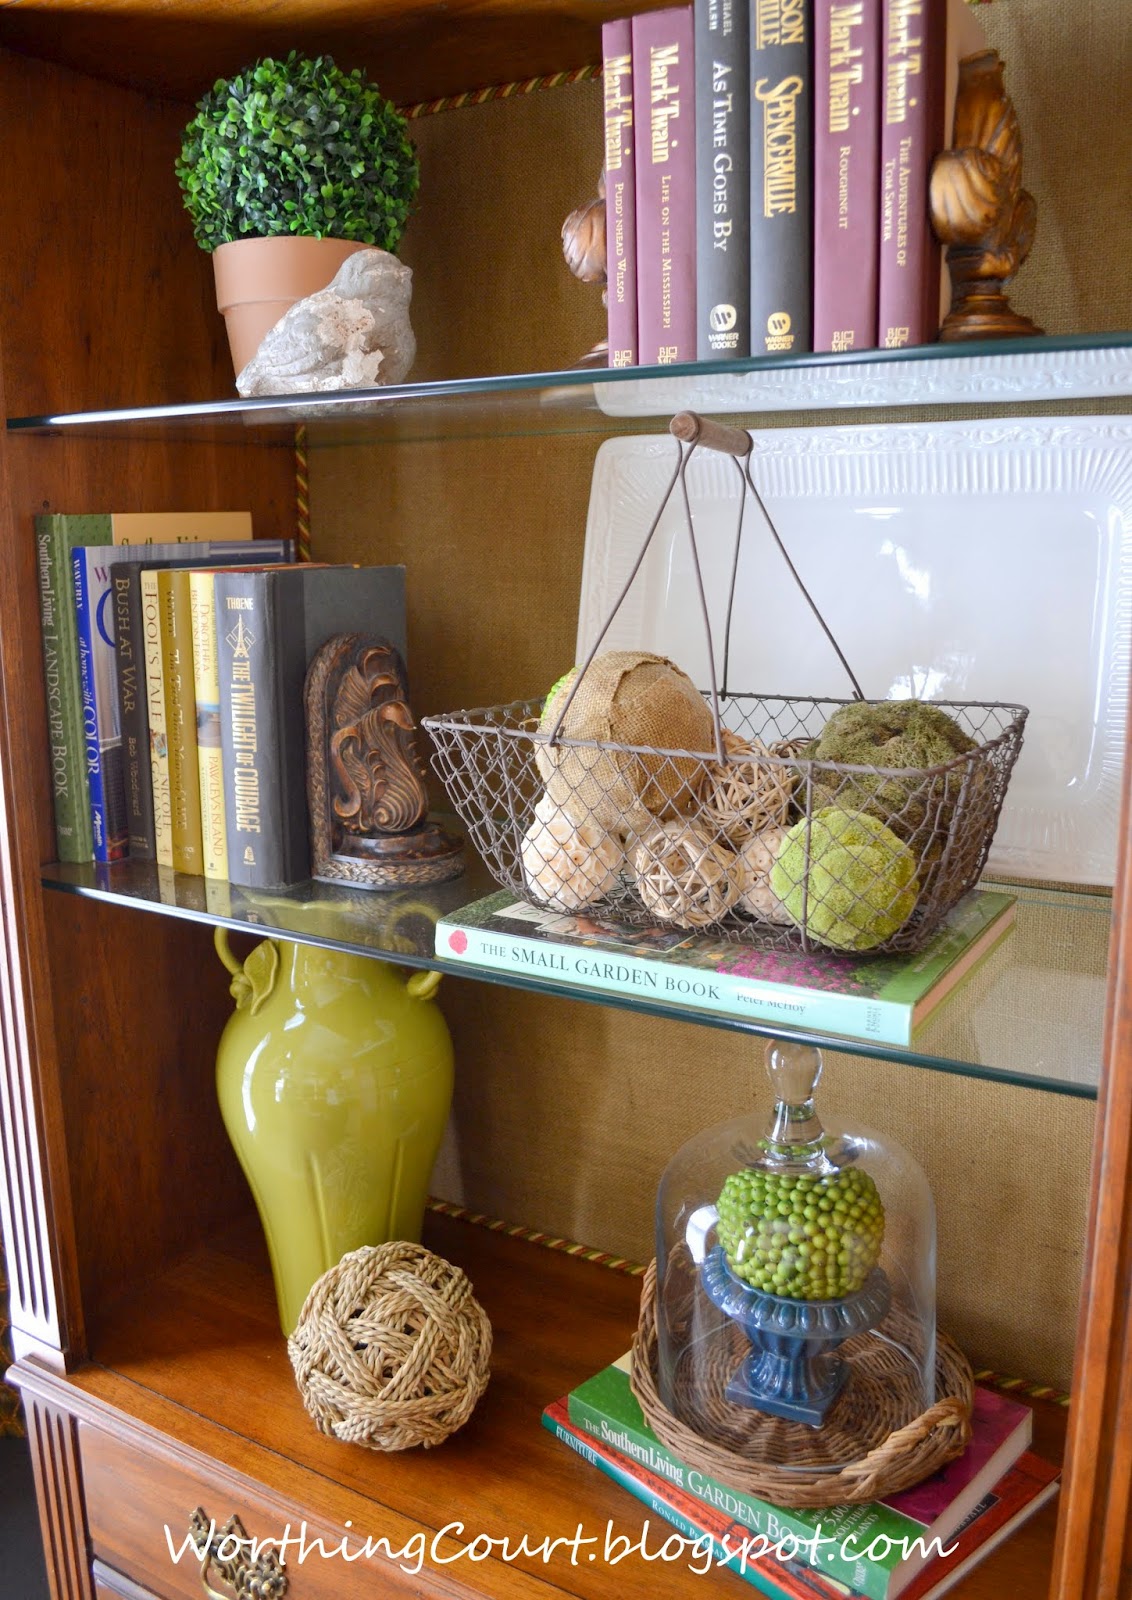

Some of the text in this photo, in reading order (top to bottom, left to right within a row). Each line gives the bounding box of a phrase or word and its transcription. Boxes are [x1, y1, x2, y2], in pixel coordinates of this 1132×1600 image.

[651, 43, 680, 165] Mark Twain
[829, 2, 864, 133] Mark Twain
[886, 0, 922, 125] Mark Twain
[604, 53, 633, 172] Mark Twain
[755, 75, 804, 218] SPENCERVILLE
[713, 60, 733, 252] AS TIME GOES BY
[839, 145, 851, 229] ROUGHING IT
[883, 158, 896, 242] TOM SAWYER
[896, 136, 912, 267] THE ADVENTURES OF
[616, 257, 627, 303] WILSON
[661, 175, 672, 329] LIFE ON THE MISSISSIPPI
[708, 332, 739, 342] WARNER
[711, 341, 738, 350] BOOKS
[764, 335, 795, 345] WARNER
[766, 342, 793, 351] BOOKS
[191, 589, 199, 640] BENTON
[200, 603, 210, 672] DOROTHEA
[225, 596, 254, 611] THOENE
[44, 636, 64, 740] LANDSCAPE
[73, 559, 83, 610] WAVERLY
[83, 705, 100, 775] COLOR
[115, 577, 142, 816] BUSH AT WAR Bob Woodward
[150, 671, 162, 722] TALE
[52, 744, 69, 798] BOOK
[231, 661, 261, 833] THE TWILIGHT OF COURAGE
[160, 772, 172, 827] NICOLE
[212, 813, 224, 857] ISLAND
[481, 942, 506, 958] THE
[511, 947, 569, 971] SMALL
[575, 958, 658, 988] GARDEN
[665, 977, 720, 1000] BOOK
[556, 1425, 730, 1565] FURNITURE RONALD PEARAL
[583, 1417, 601, 1436] THE
[687, 1470, 761, 1530] GARDEN
